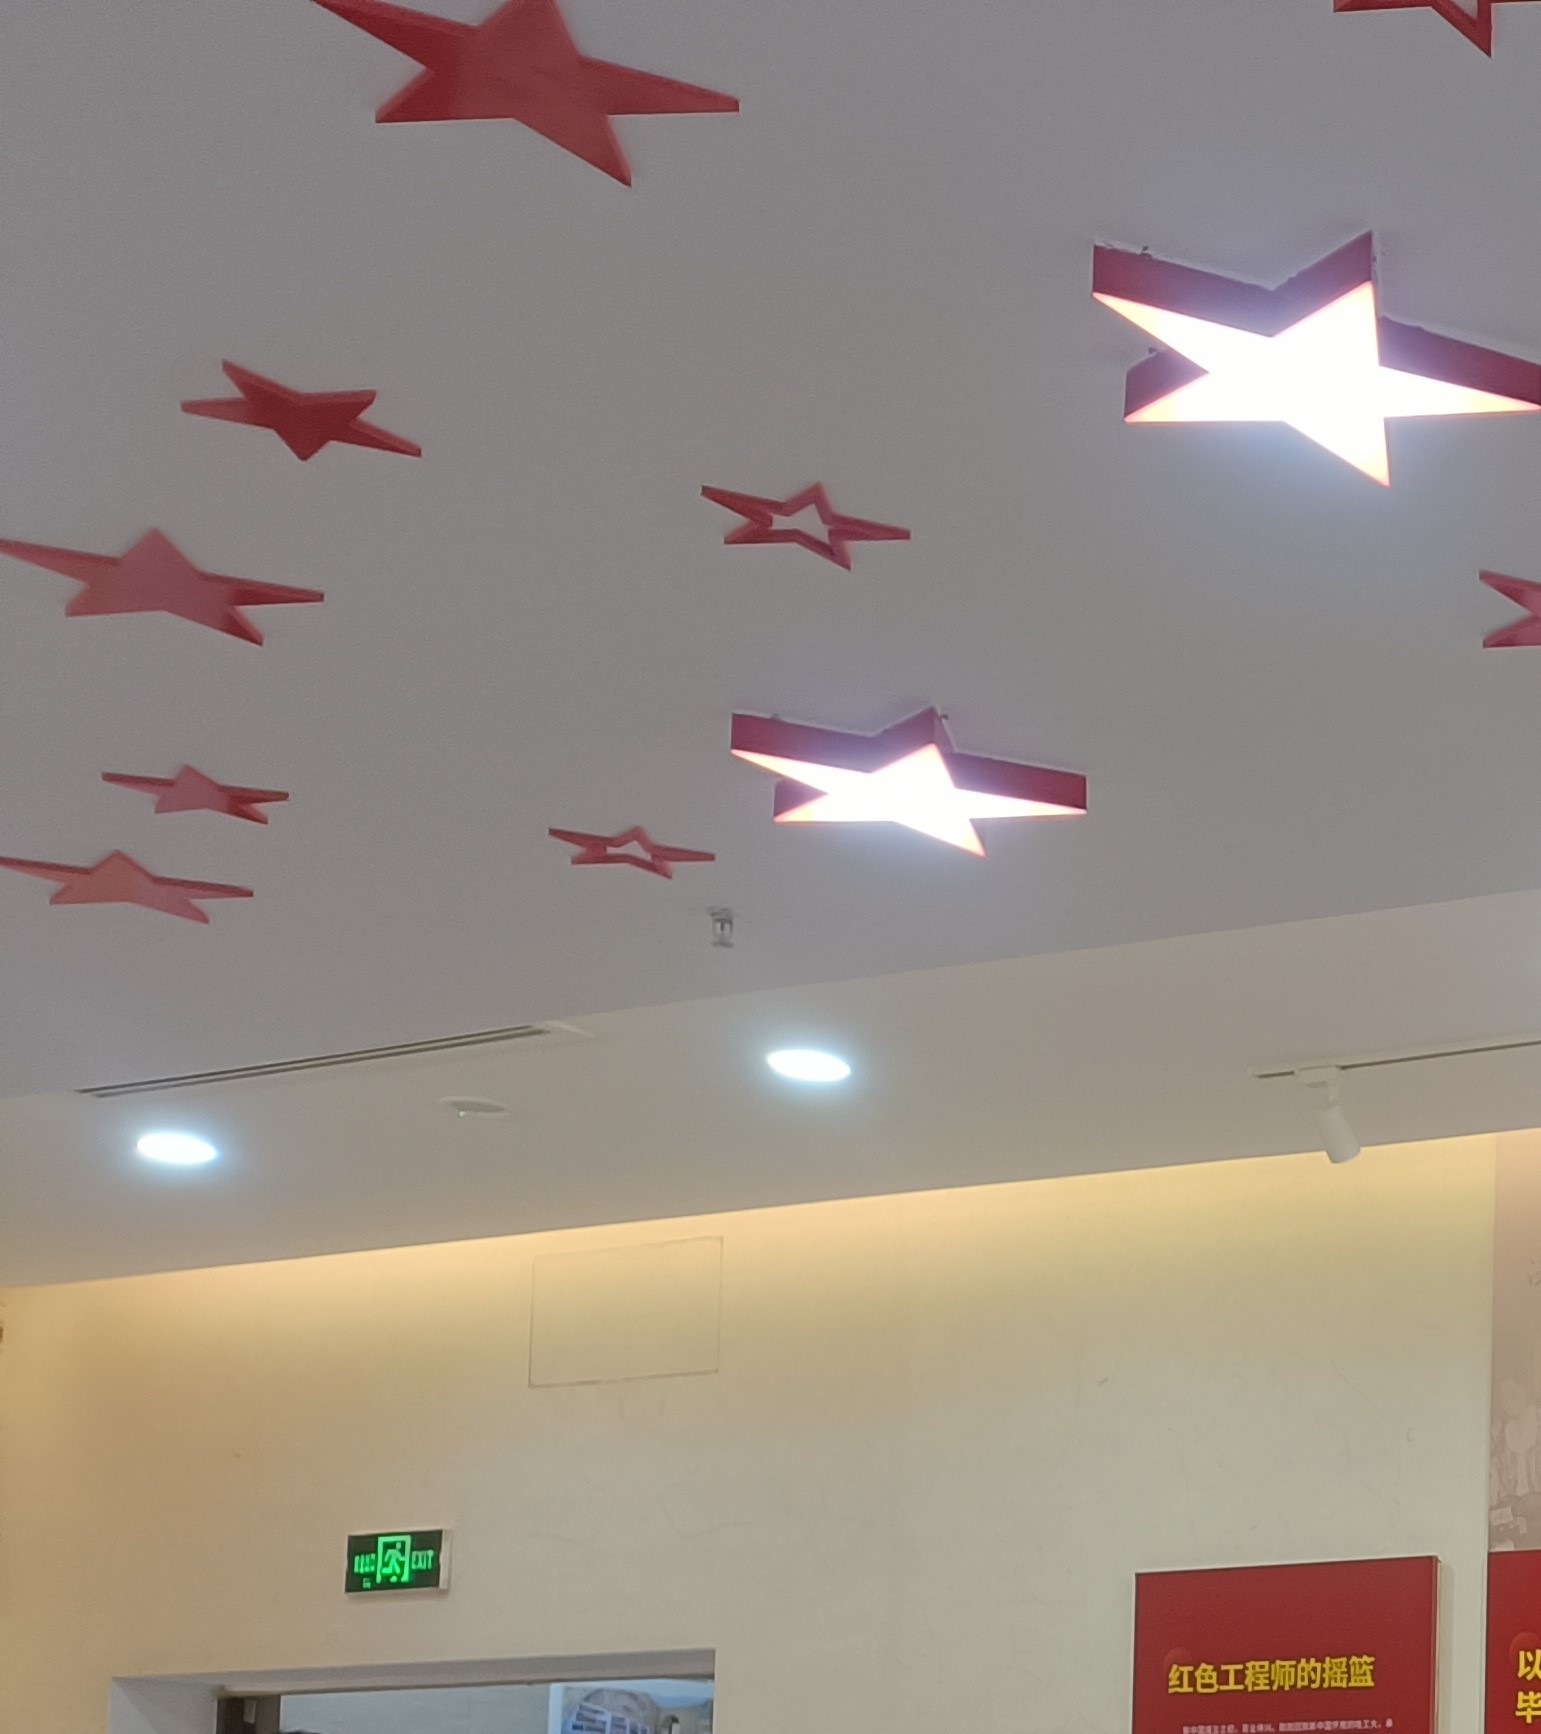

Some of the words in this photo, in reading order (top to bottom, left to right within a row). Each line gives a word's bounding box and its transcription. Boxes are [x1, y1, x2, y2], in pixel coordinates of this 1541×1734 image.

[1167, 1655, 1376, 1694] 红色工程师的摇篮
